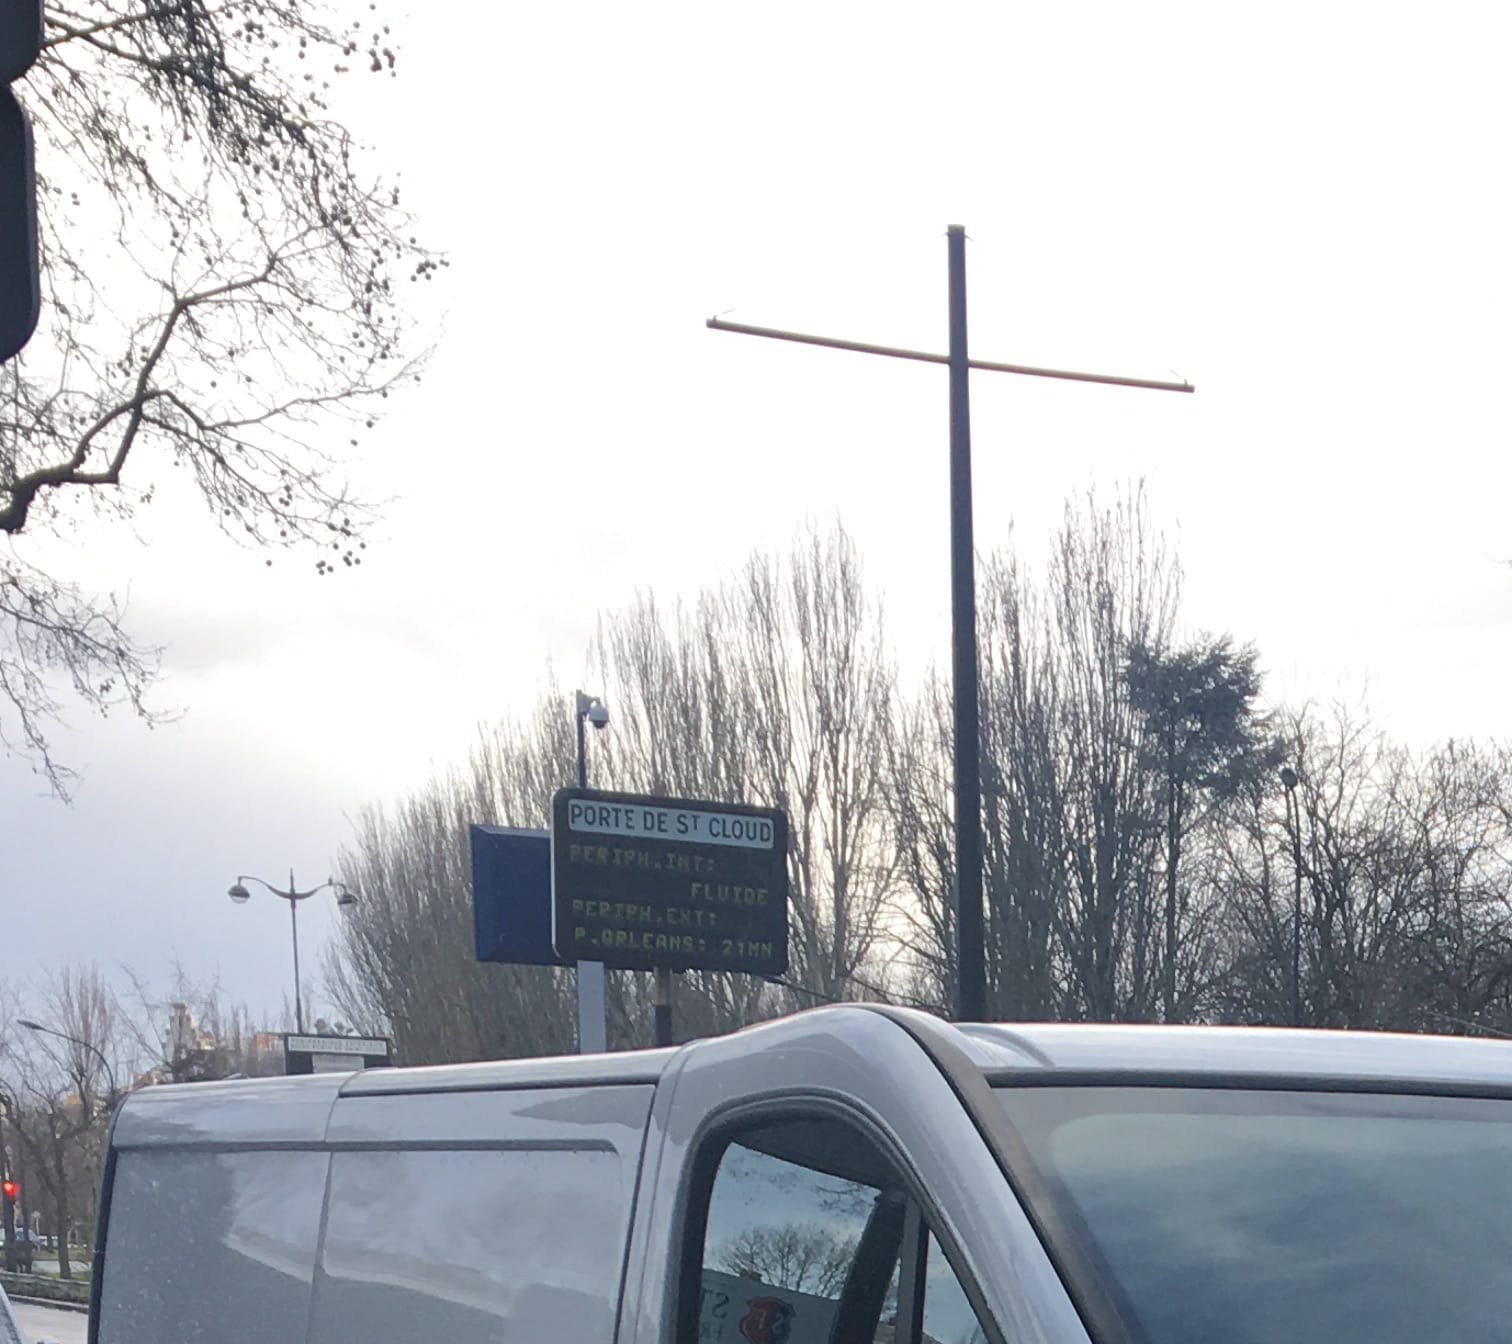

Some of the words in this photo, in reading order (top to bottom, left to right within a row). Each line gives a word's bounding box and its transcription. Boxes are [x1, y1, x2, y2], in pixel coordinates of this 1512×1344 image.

[571, 803, 635, 830] PORTE
[643, 810, 668, 833] DE
[708, 817, 772, 843] CLOUD
[690, 882, 769, 905] FLUIDE
